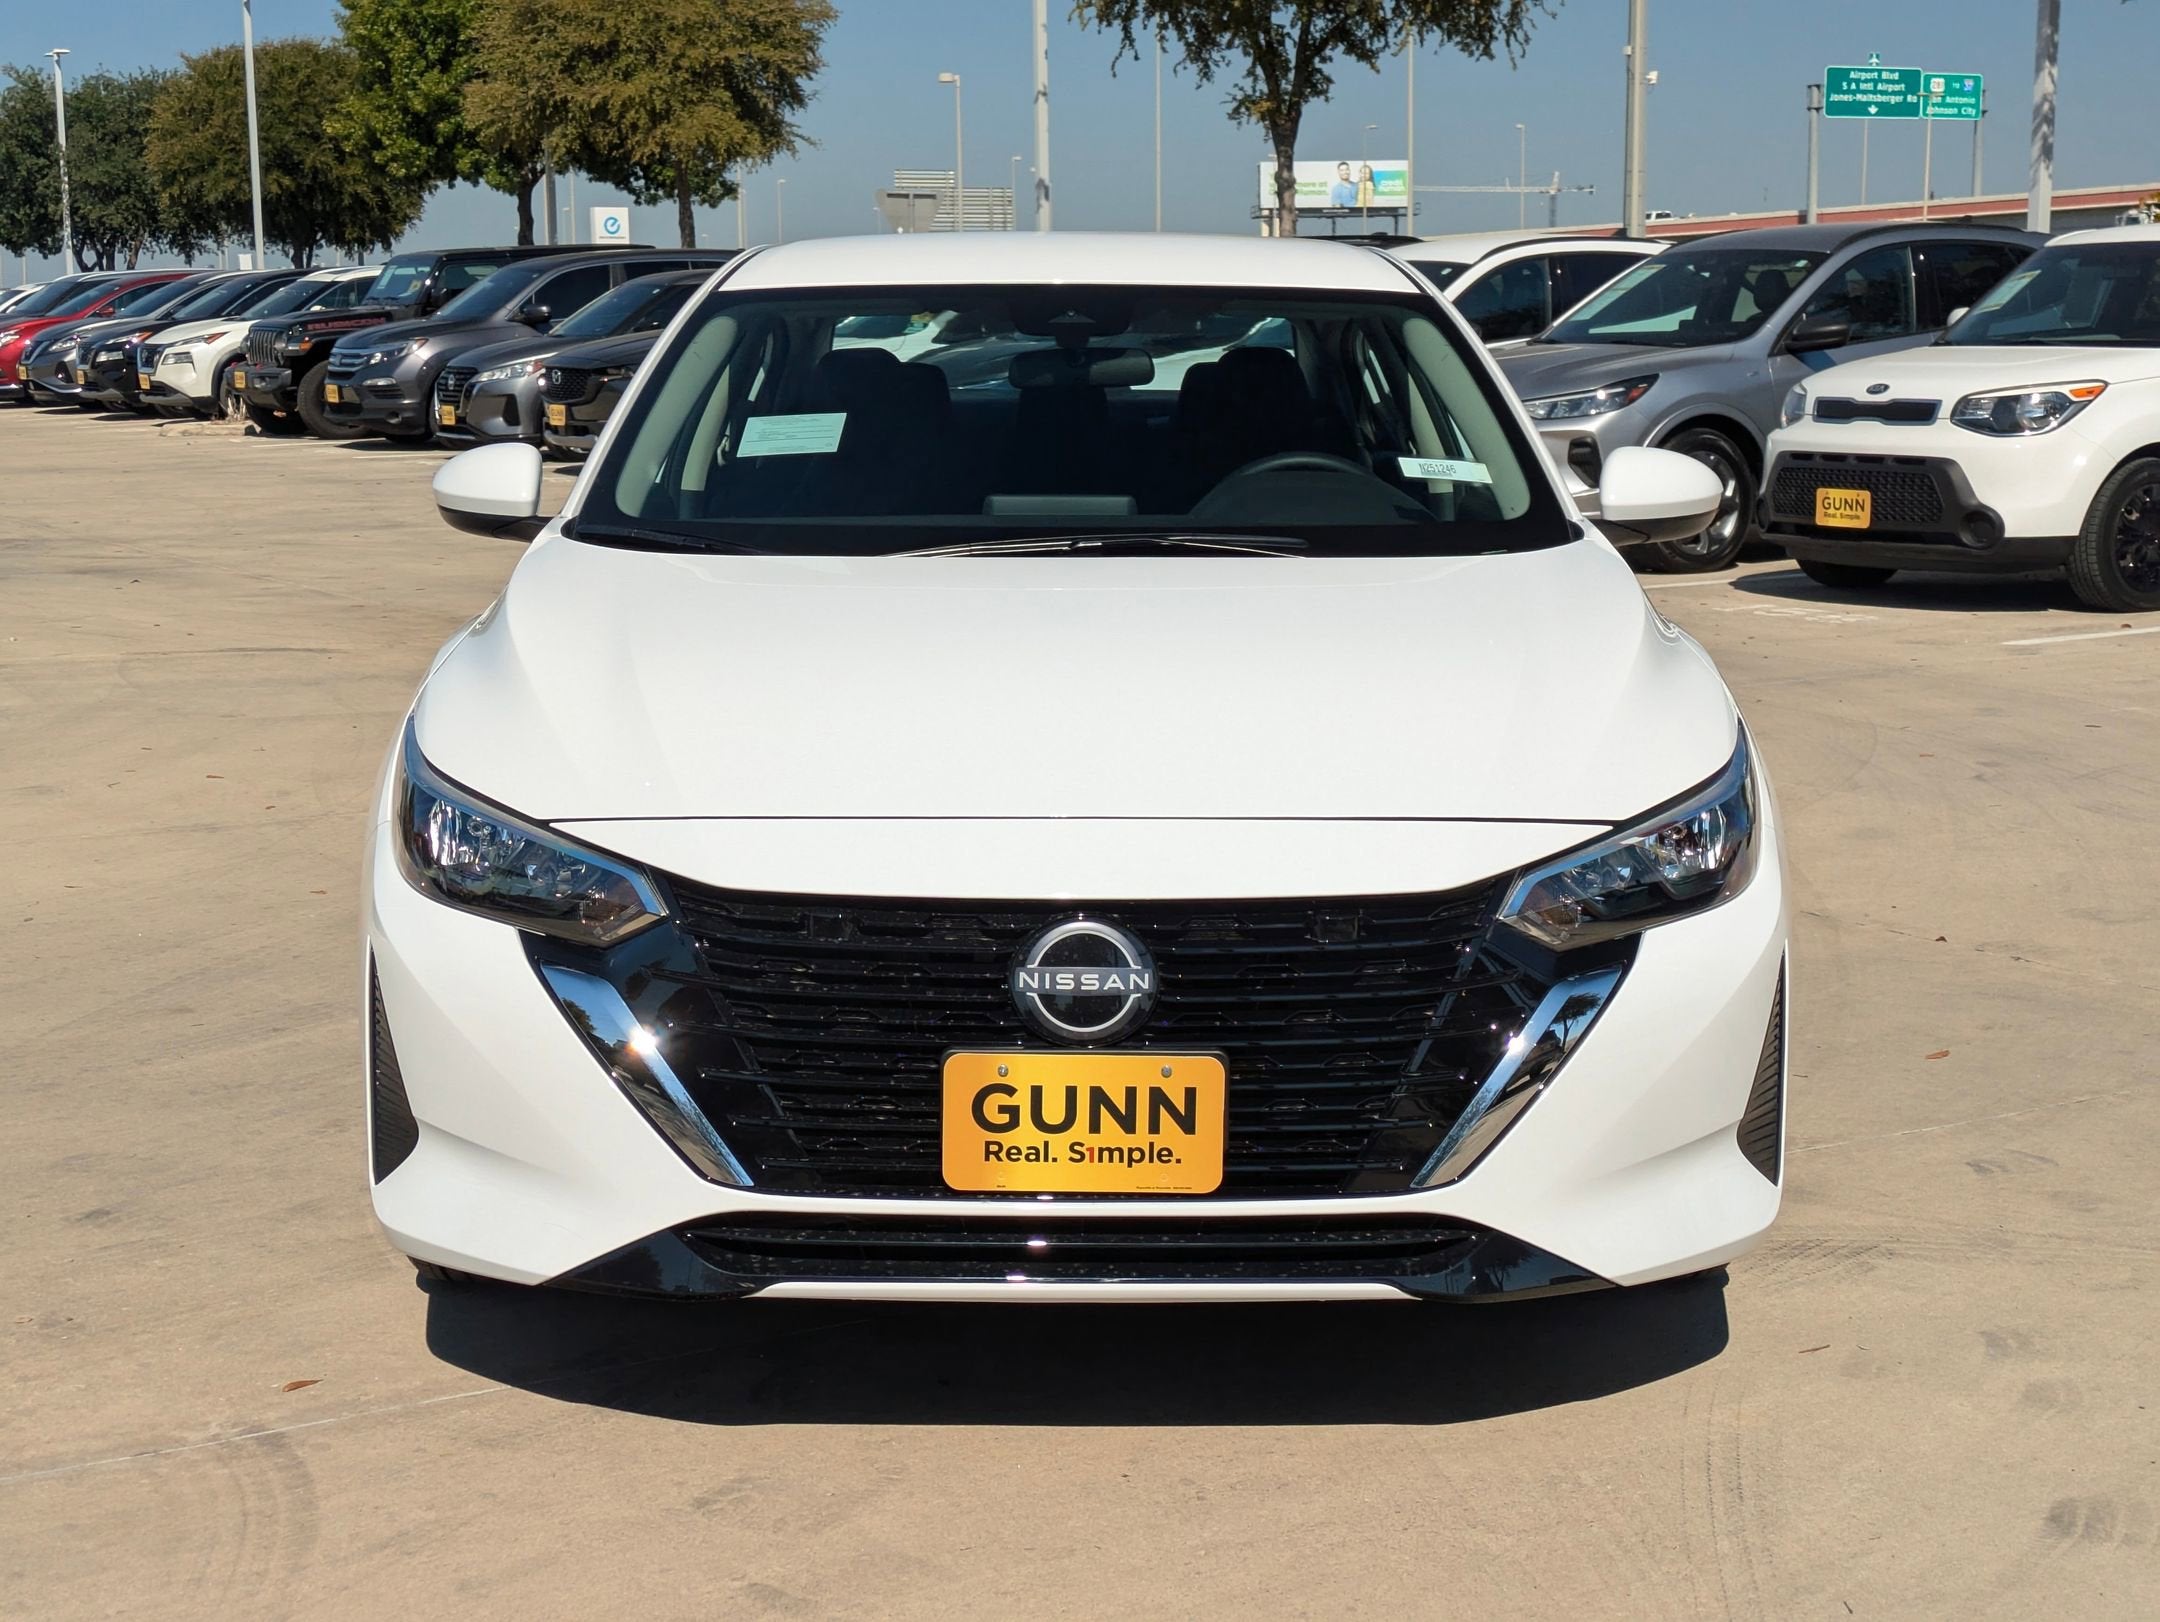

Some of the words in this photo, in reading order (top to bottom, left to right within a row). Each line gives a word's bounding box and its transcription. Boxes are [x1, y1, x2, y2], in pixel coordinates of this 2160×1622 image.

[1849, 70, 1878, 80] Airport
[1881, 71, 1899, 80] Blvd
[1842, 81, 1848, 90] S
[1850, 82, 1856, 90] A
[1877, 82, 1905, 93] Airport
[1945, 95, 1976, 104] Antonio
[1961, 106, 1976, 117] City
[1822, 496, 1865, 512] GUNN
[1018, 971, 1149, 990] NISSAN
[971, 1083, 1197, 1136] GUNN
[984, 1140, 1058, 1163] Real.
